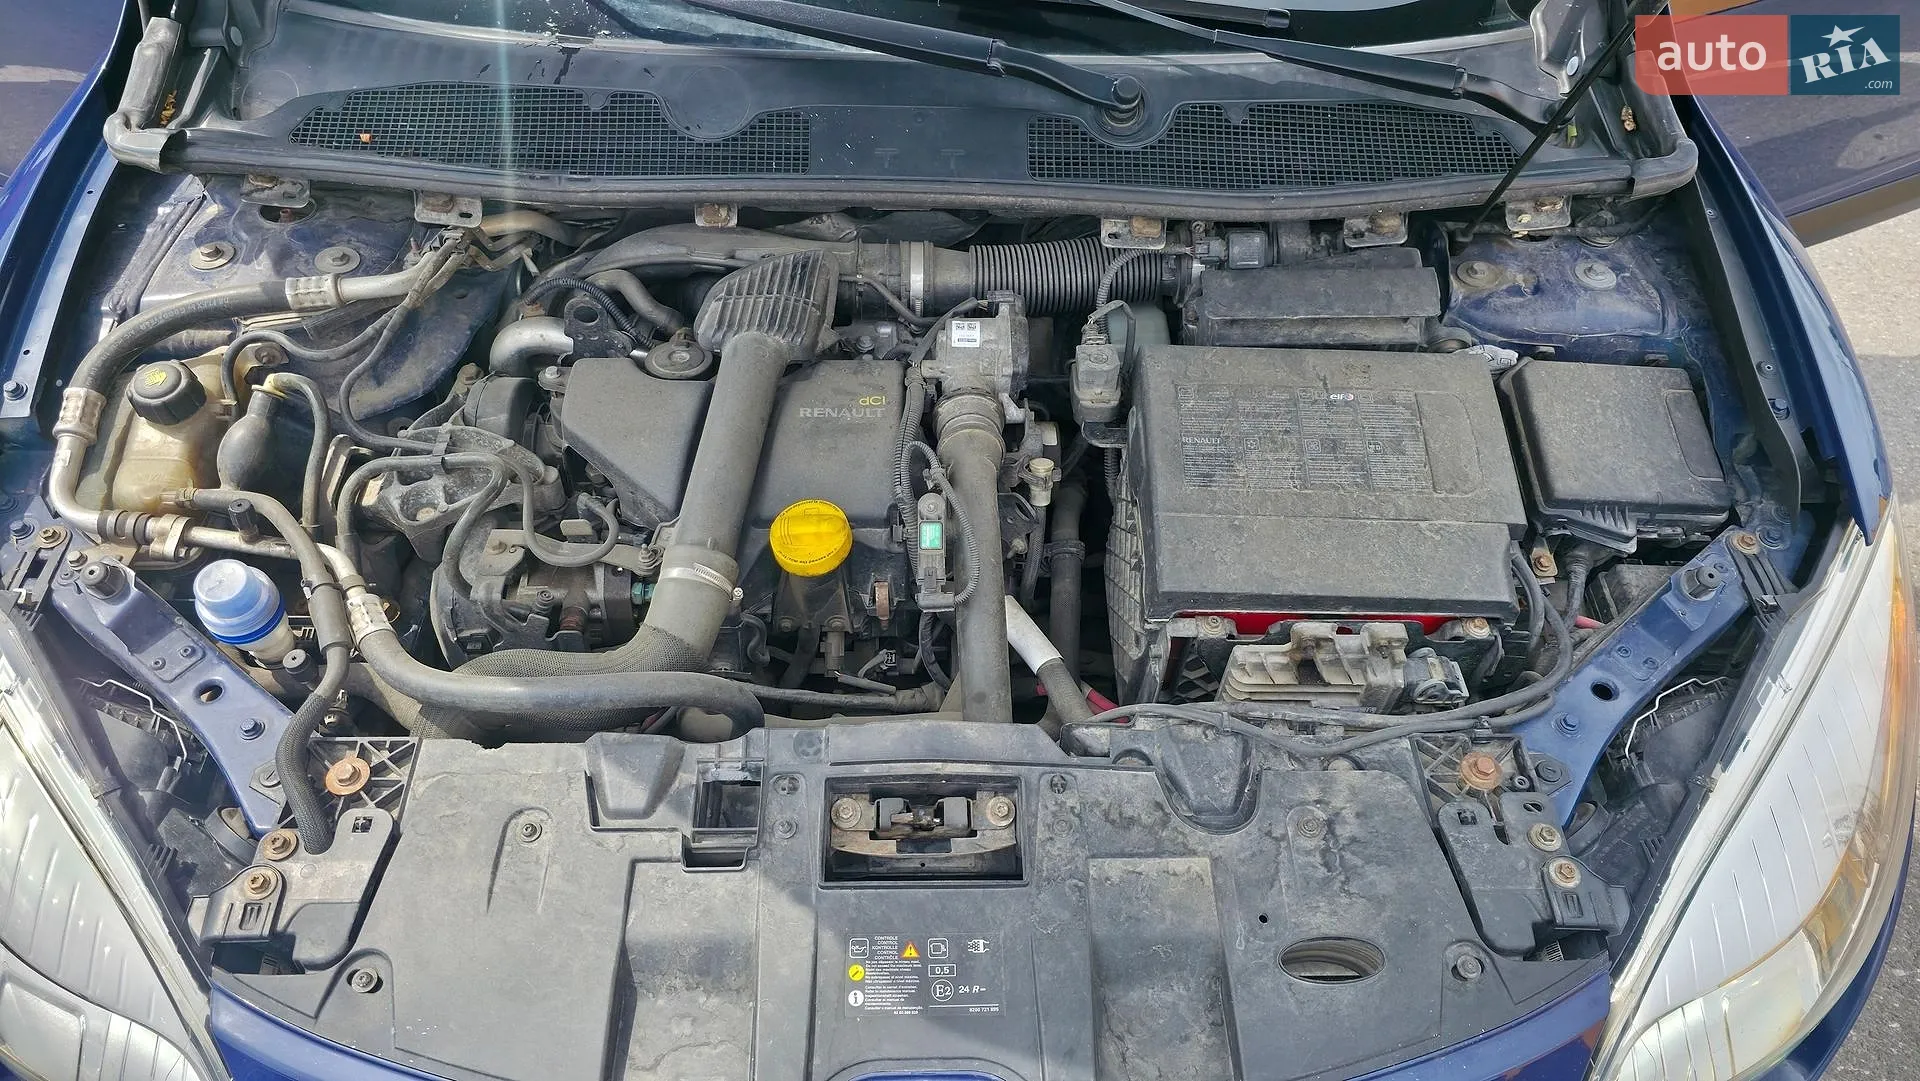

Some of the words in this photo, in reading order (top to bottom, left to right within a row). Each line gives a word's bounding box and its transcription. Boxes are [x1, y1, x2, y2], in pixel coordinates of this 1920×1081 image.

[799, 407, 886, 418] RENAULT
[935, 984, 951, 997] E2
[958, 985, 970, 994] 24
